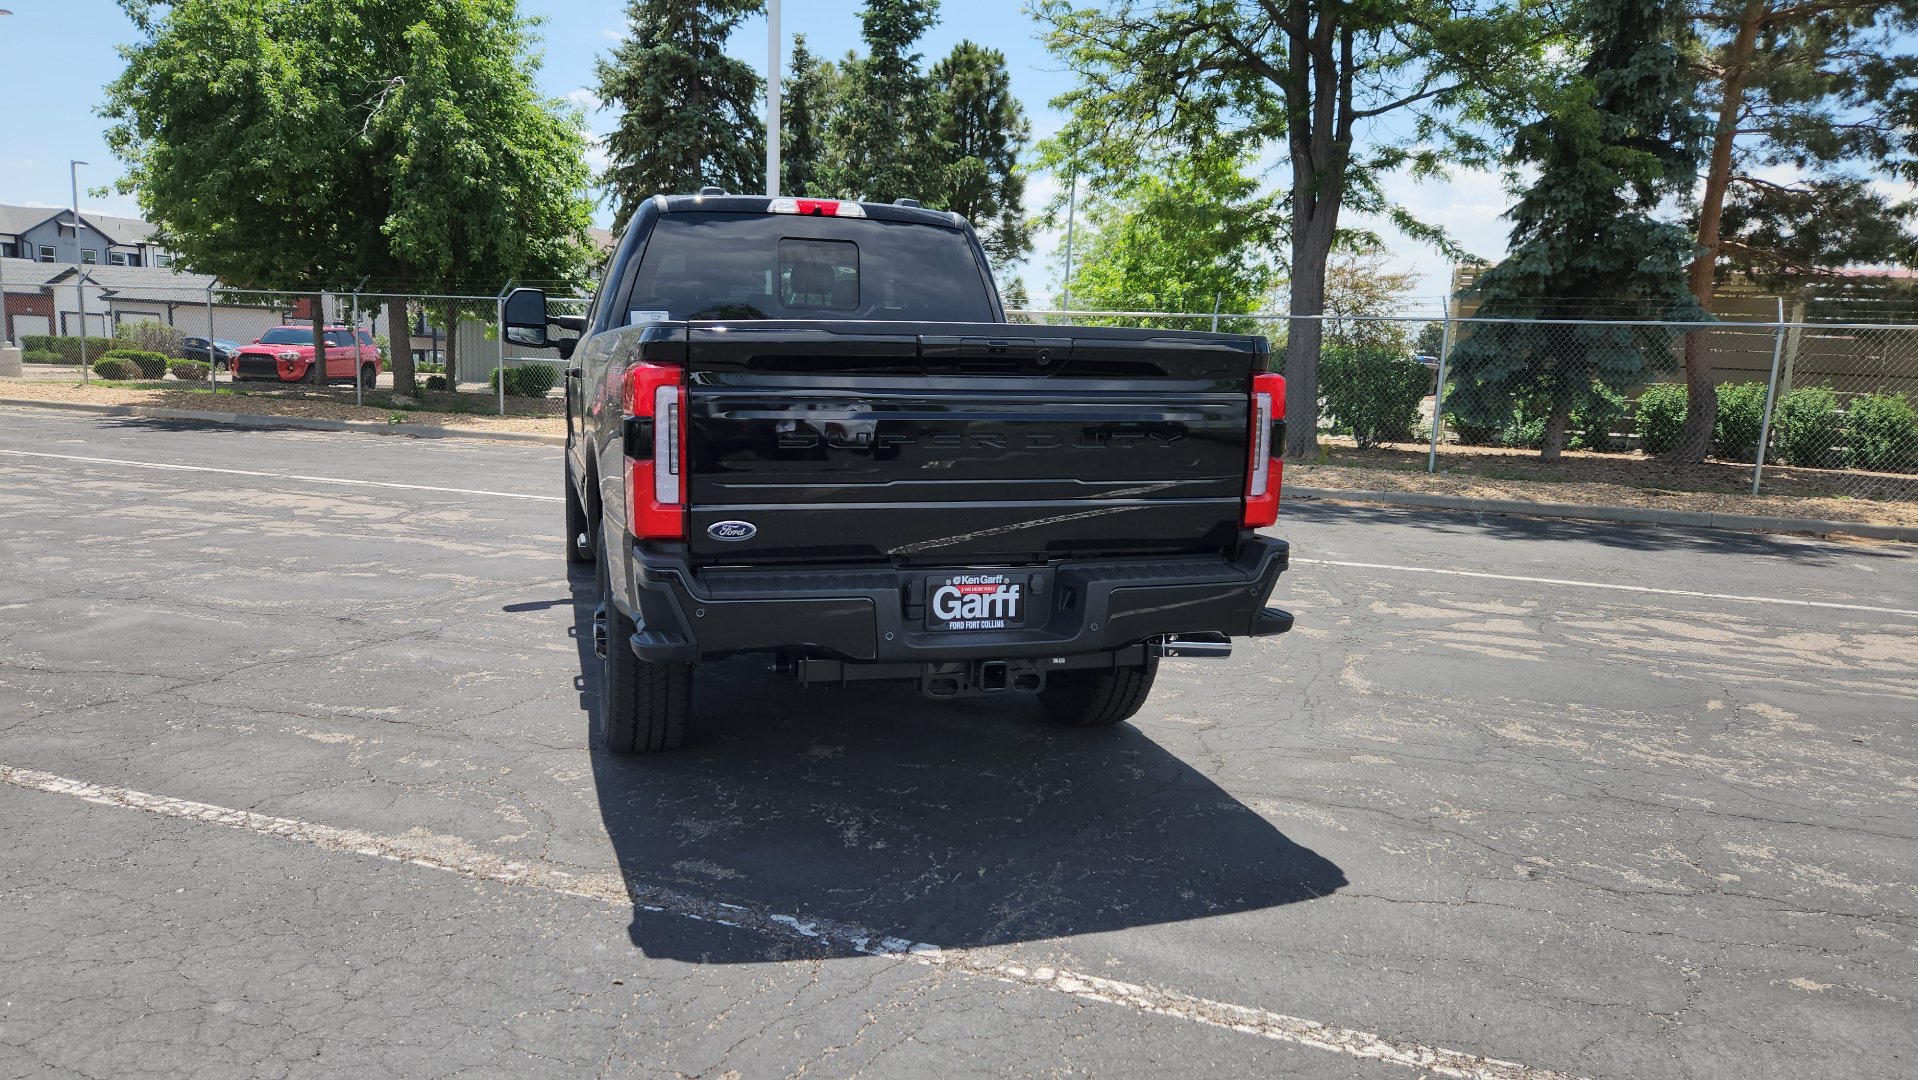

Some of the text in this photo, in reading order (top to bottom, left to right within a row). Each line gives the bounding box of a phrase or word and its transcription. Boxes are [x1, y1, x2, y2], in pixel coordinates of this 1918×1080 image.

[719, 525, 746, 536] Ford
[962, 575, 1003, 584] Ken Garff
[933, 585, 1020, 620] Garff
[949, 620, 1004, 629] FORD FORT COLLINS
